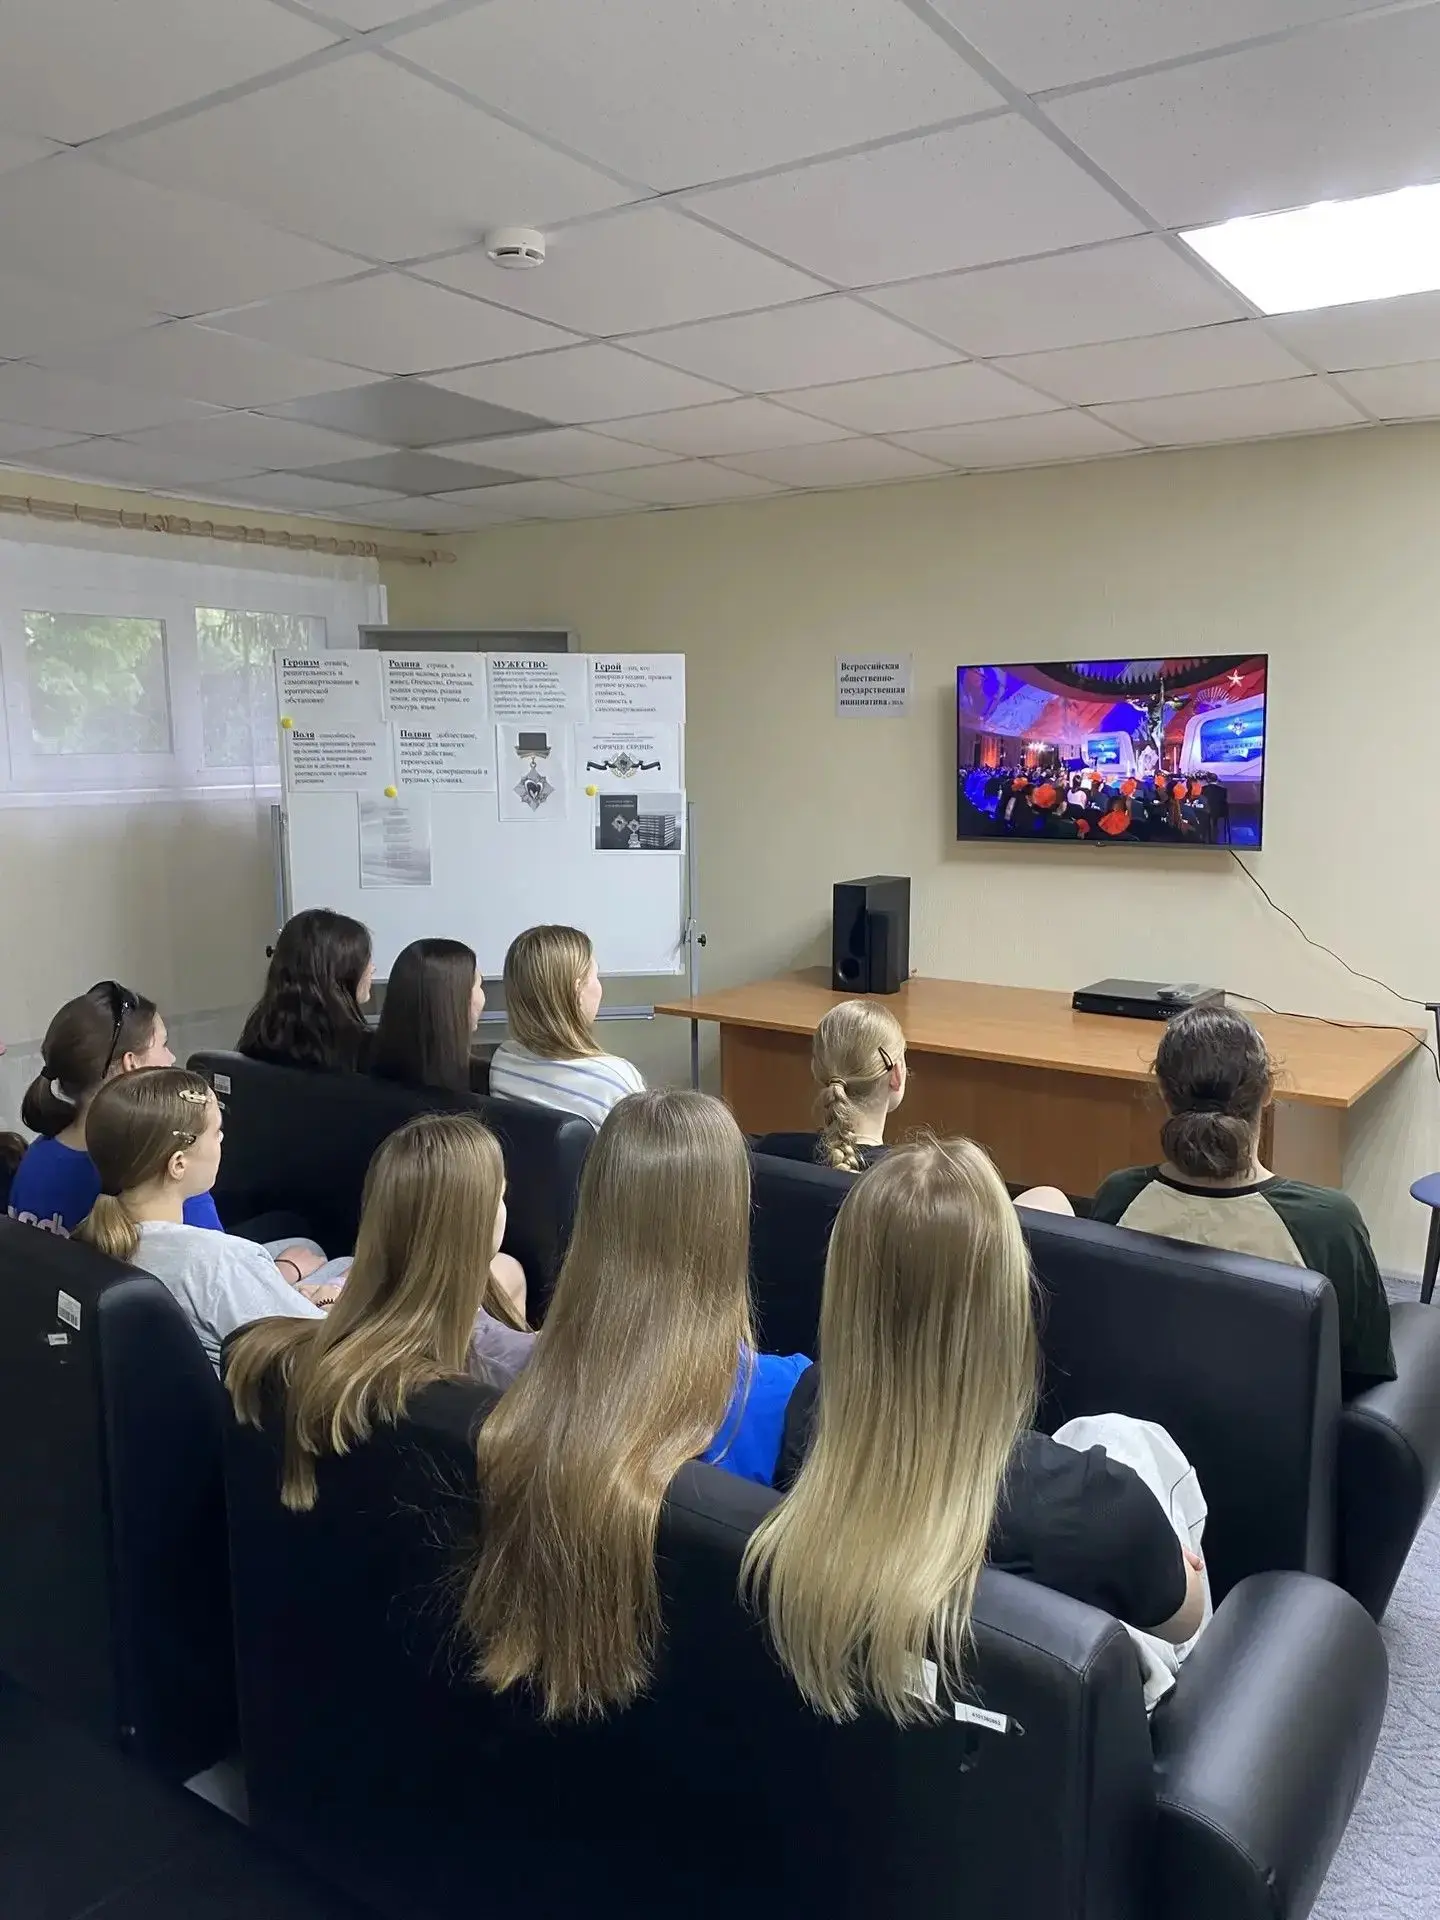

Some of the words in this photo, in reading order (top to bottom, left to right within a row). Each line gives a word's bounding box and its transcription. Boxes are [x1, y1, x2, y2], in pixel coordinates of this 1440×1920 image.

[283, 658, 320, 668] Героизм
[389, 660, 423, 669] Родина
[594, 662, 622, 672] Герой
[841, 662, 900, 672] Всероссийская
[840, 674, 894, 682] общественно-
[840, 687, 906, 696] государственная
[293, 730, 315, 740] Воля
[400, 729, 432, 740] Подвиг
